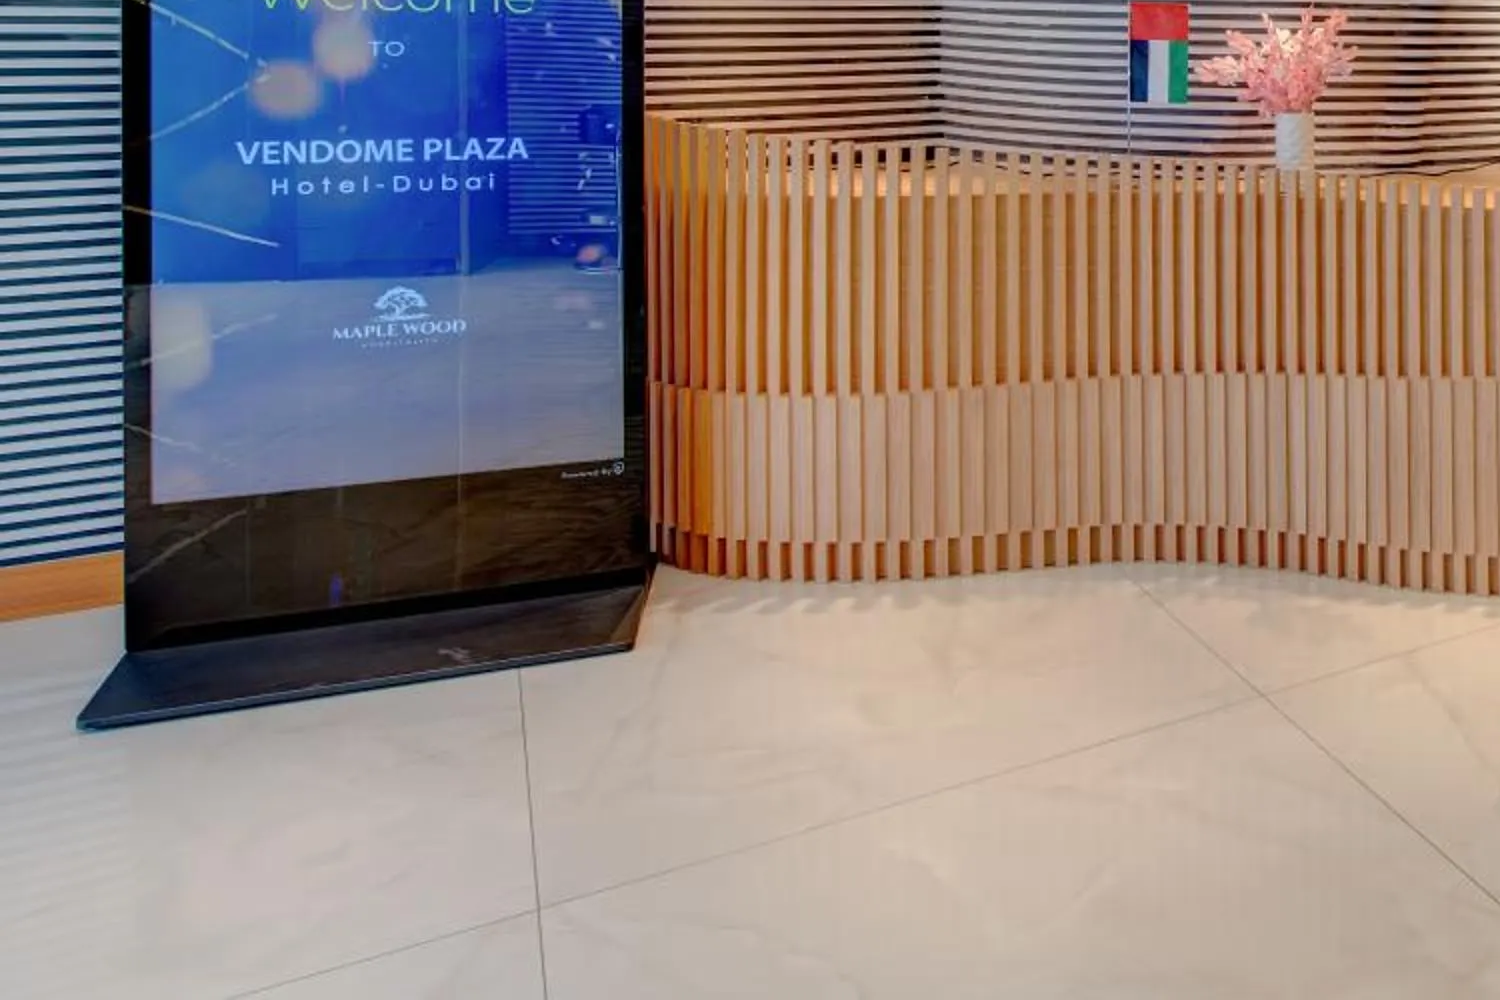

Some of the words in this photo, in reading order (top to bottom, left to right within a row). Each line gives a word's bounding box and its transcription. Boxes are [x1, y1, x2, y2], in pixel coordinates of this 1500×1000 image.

[368, 41, 405, 57] TO
[236, 139, 414, 165] VENDOME
[423, 137, 529, 161] PLAZA
[270, 172, 496, 196] Hotel-Dubai
[332, 323, 399, 339] MAPLE
[402, 318, 467, 335] WOOD
